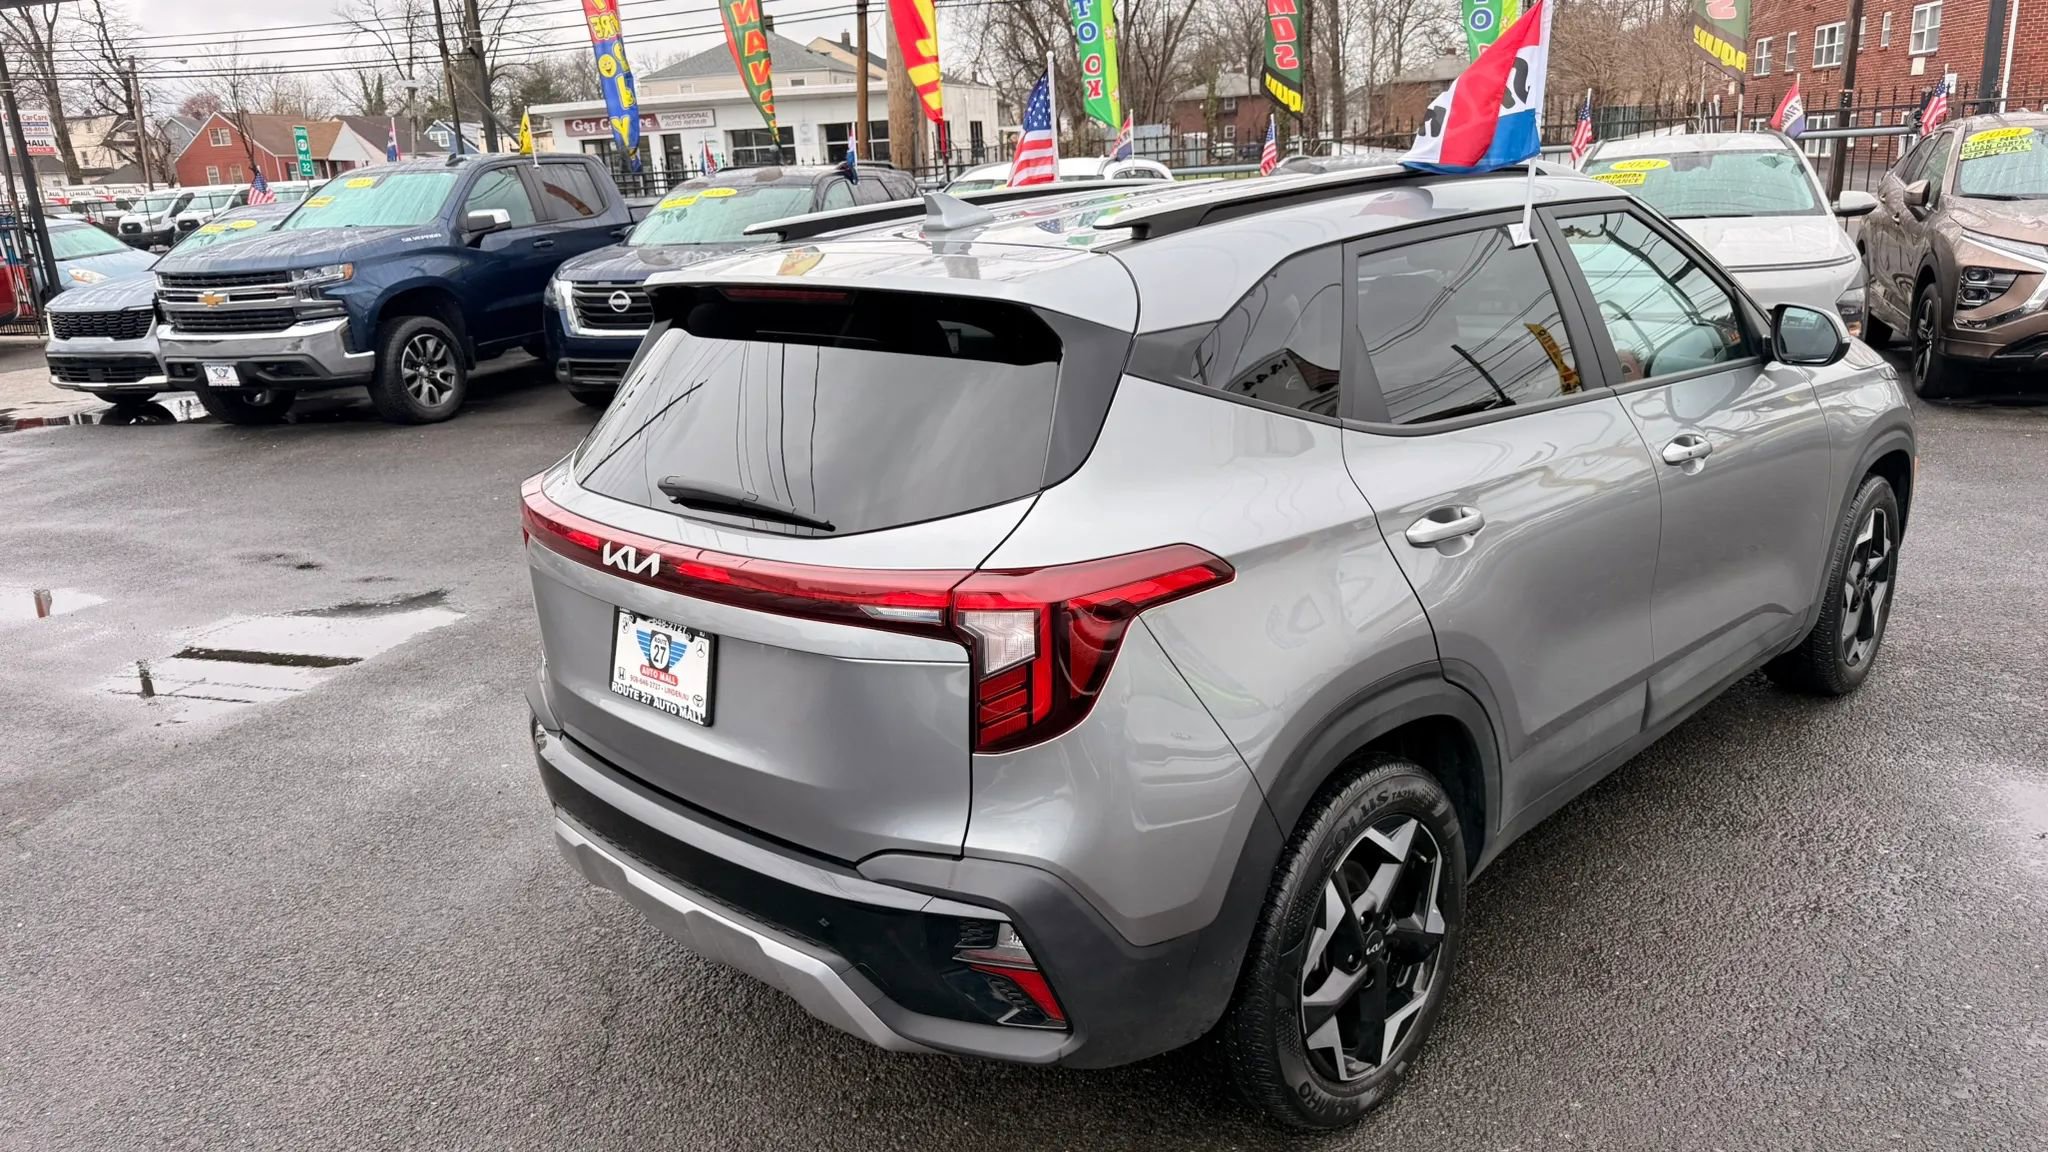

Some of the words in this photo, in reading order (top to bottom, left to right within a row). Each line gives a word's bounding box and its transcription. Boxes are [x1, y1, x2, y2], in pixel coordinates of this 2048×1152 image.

[661, 111, 710, 121] PROFESSIONAL
[665, 119, 682, 127] AUTO
[684, 118, 708, 127] REPAIR
[602, 540, 661, 578] KIA
[654, 637, 668, 645] ROUTE
[653, 644, 667, 665] 27
[641, 667, 659, 677] AUTO
[659, 671, 677, 685] MALL
[611, 681, 641, 701] ROUTE
[640, 691, 652, 705] 27
[653, 697, 677, 715] AUTO
[679, 704, 704, 725] MALL
